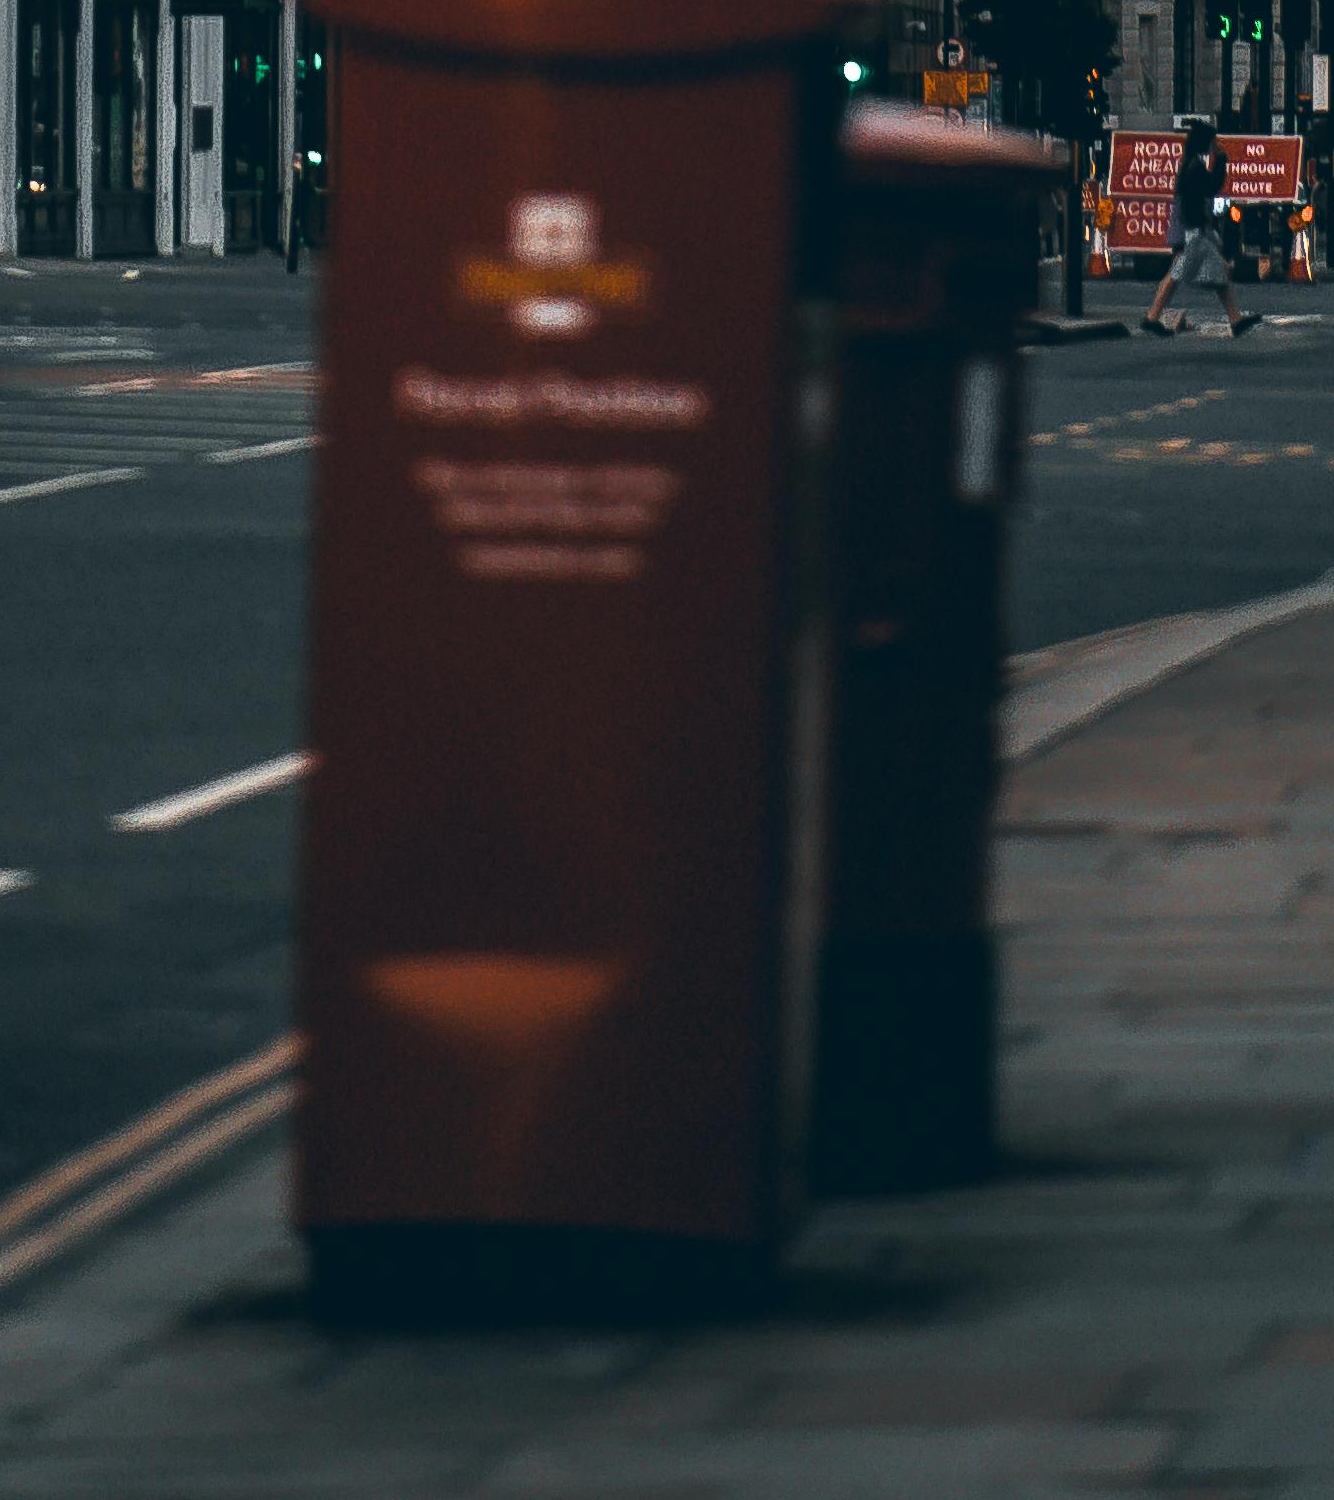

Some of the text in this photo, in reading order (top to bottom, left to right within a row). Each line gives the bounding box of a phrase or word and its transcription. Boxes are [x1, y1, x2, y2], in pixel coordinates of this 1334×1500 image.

[1134, 141, 1183, 157] ROAD
[1246, 145, 1265, 157] NO
[1226, 162, 1285, 176] THROUGH
[1232, 181, 1273, 194] ROUTE
[1126, 218, 1171, 237] ONL
